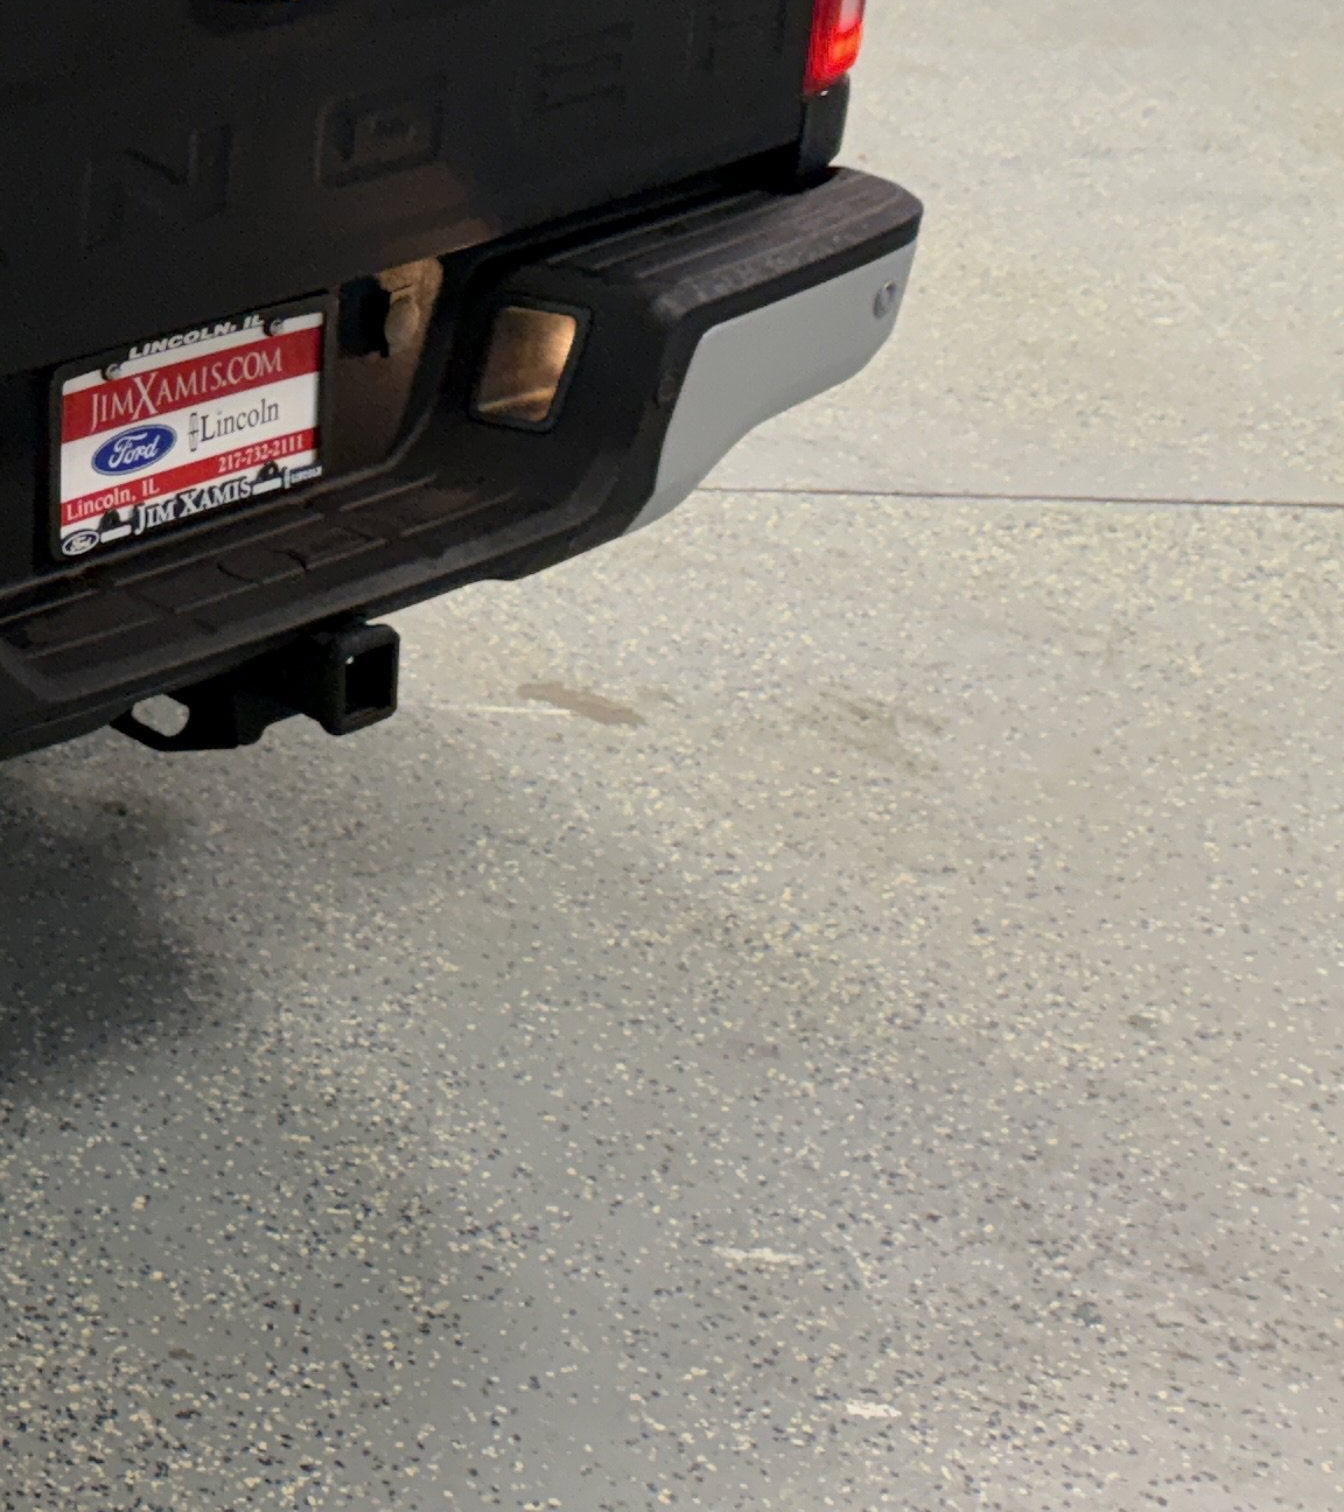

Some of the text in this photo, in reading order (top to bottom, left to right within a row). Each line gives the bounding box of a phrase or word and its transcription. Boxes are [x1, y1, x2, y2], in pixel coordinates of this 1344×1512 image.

[90, 347, 283, 432] JIMXAMIS.COM
[200, 398, 279, 442] Lincoln
[108, 434, 160, 468] Ford
[218, 434, 303, 473] 217-732-2111
[135, 479, 252, 535] JIM XAMIS
[142, 478, 160, 496] IL
